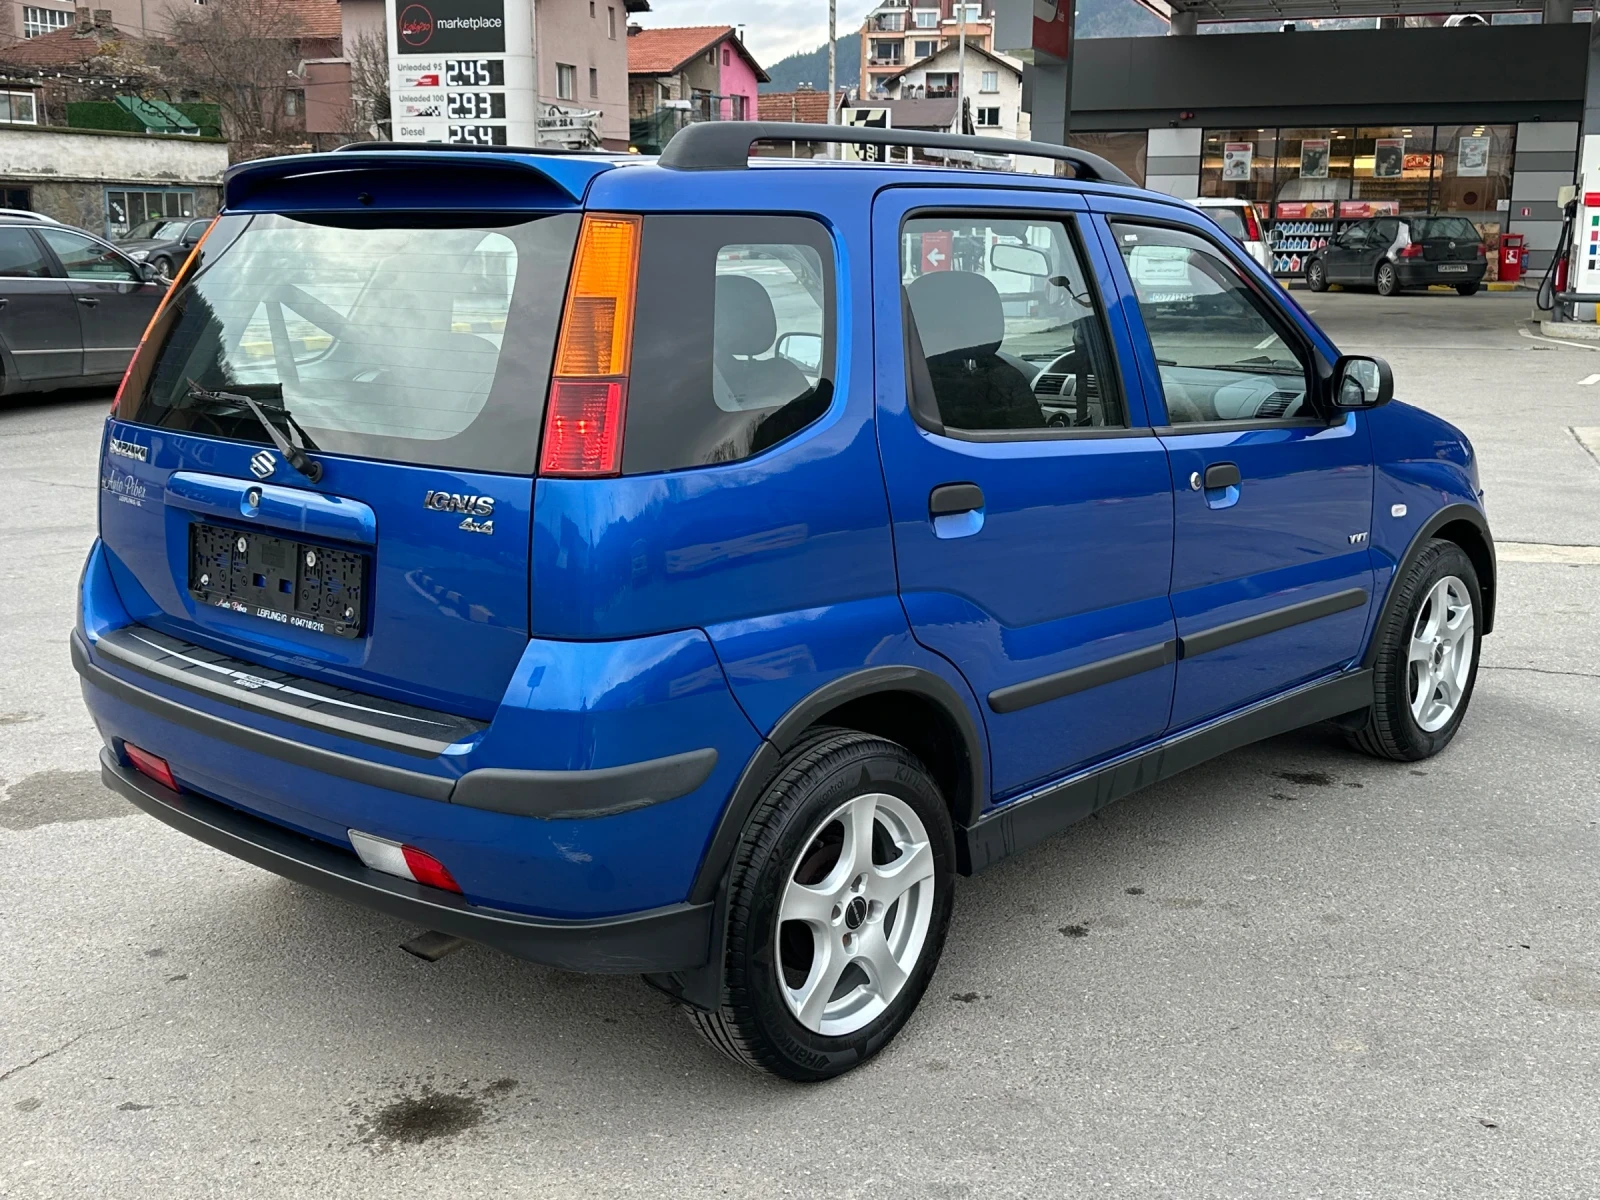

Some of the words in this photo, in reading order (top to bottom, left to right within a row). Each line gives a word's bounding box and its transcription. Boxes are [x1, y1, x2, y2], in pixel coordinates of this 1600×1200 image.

[437, 16, 502, 31] marketplace
[397, 63, 431, 71] Unleaded
[433, 63, 443, 71] 95
[446, 60, 491, 86] 2.45
[398, 95, 431, 103] Unleaded
[433, 94, 445, 102] 100
[447, 93, 491, 119] 2.93
[401, 127, 426, 136] Diesel
[109, 438, 148, 463] SUZUKI
[423, 490, 494, 516] IGNIS
[459, 517, 494, 535] 4x4
[1348, 531, 1368, 545] VVT
